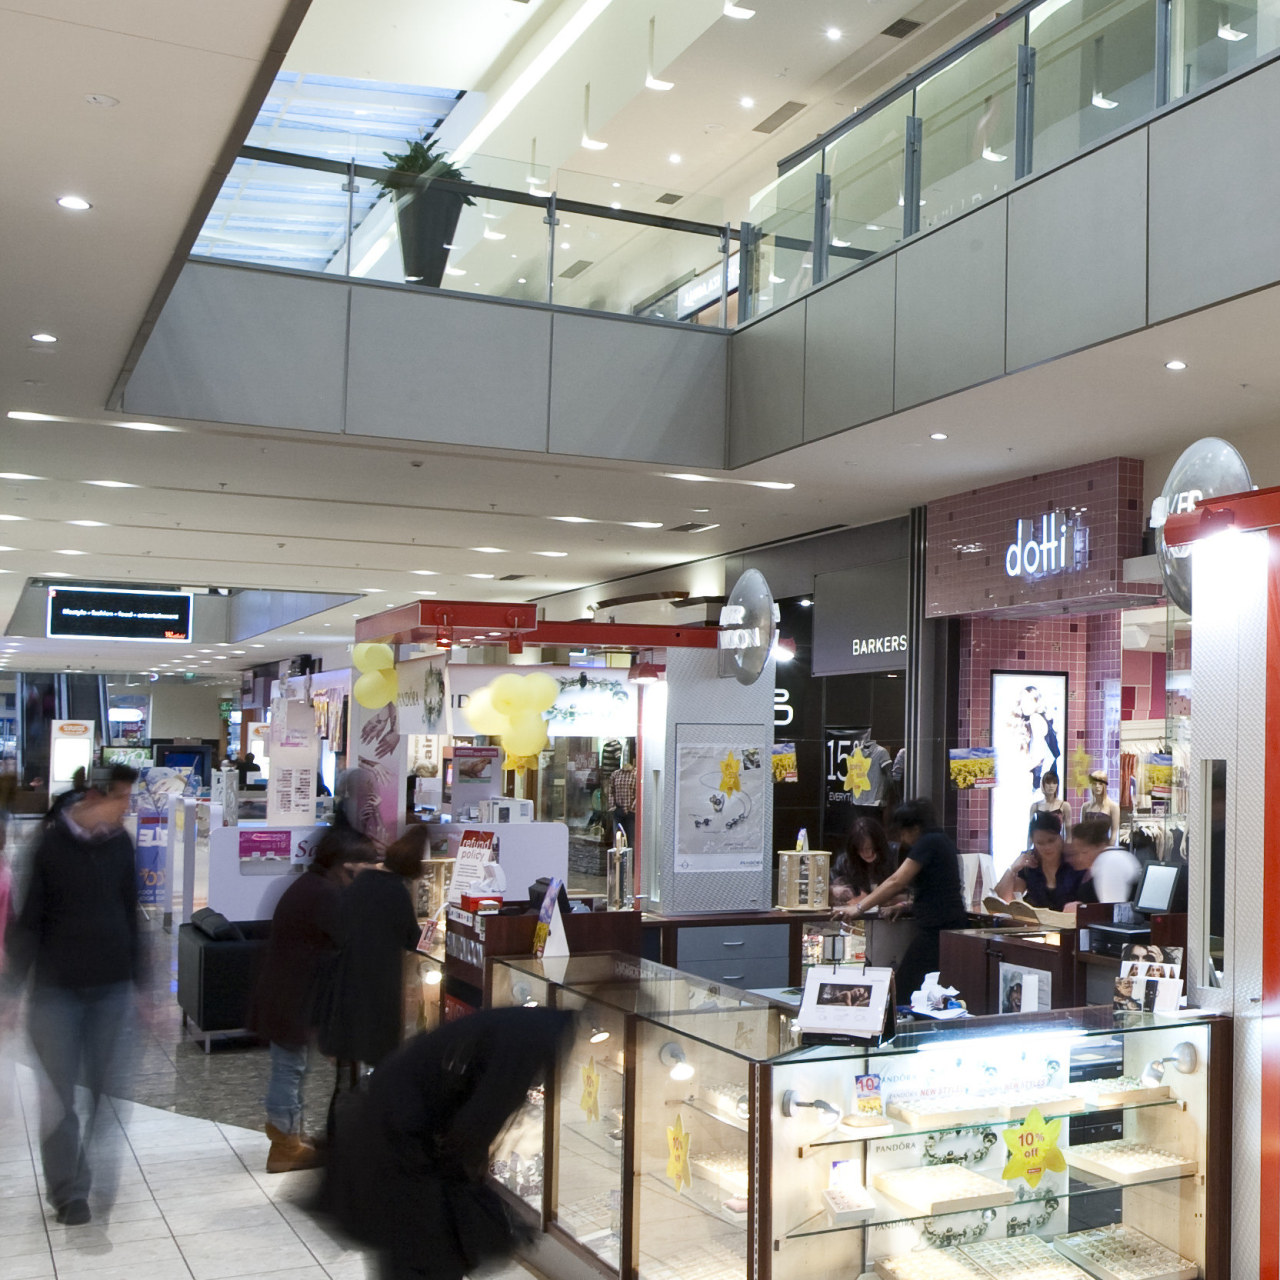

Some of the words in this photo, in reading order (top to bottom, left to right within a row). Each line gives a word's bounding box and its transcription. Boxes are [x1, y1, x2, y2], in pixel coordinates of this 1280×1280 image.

[1005, 511, 1068, 577] dotti
[852, 634, 908, 656] BARKERS
[461, 848, 486, 862] policy
[857, 1077, 876, 1093] 10
[920, 1088, 937, 1097] NEW
[1018, 1132, 1045, 1147] 10%
[875, 1141, 917, 1153] PANDORA
[1024, 1147, 1039, 1158] off
